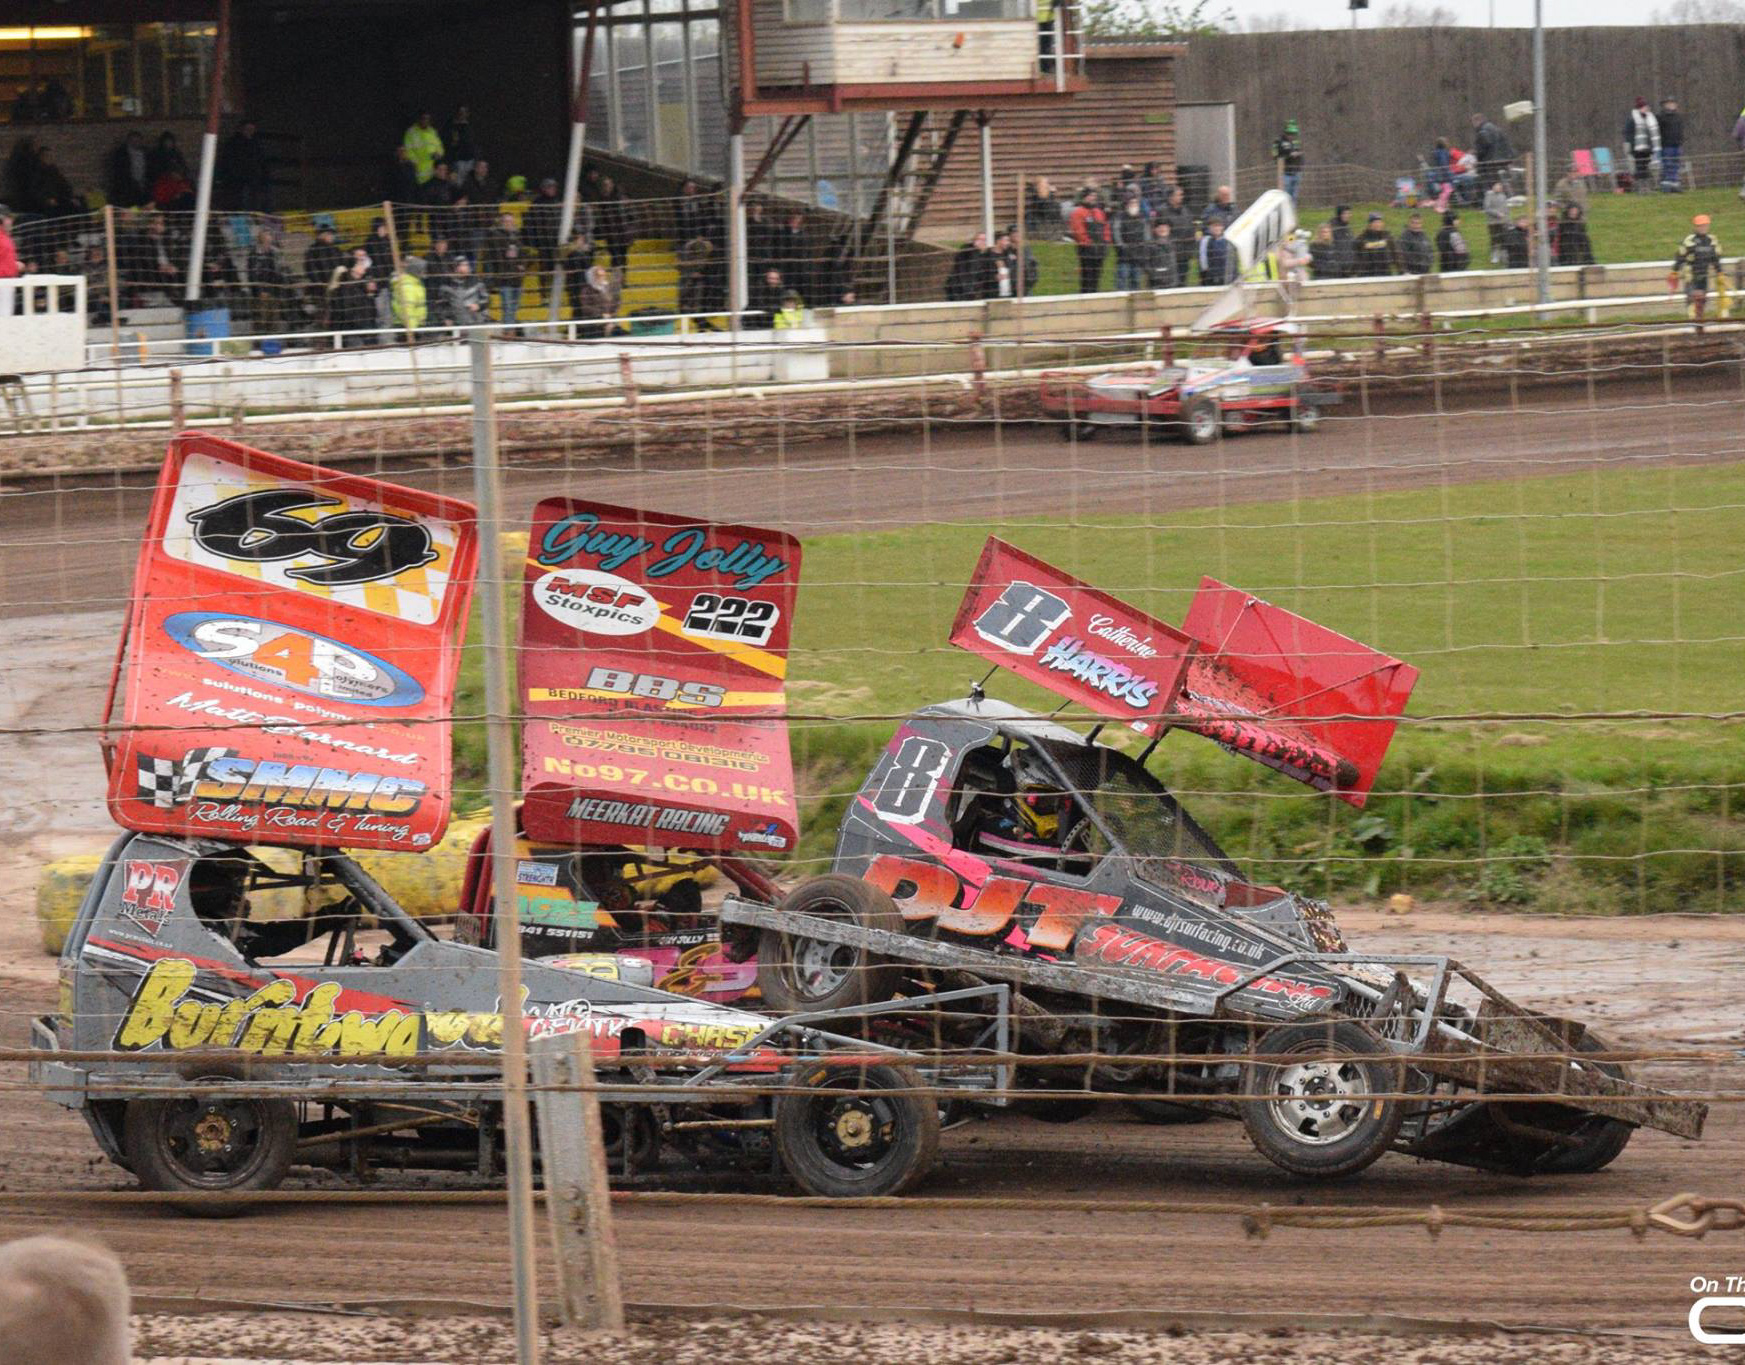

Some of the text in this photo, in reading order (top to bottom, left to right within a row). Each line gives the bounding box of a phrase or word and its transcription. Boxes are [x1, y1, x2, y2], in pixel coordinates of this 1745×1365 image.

[187, 489, 438, 585] 69
[537, 513, 789, 590] Guy Jolly
[545, 594, 644, 625] Stoxpics
[546, 577, 646, 608] MSF
[682, 594, 779, 644] 222
[972, 580, 1073, 655] 8
[1087, 613, 1157, 660] Catherine
[584, 667, 727, 707] BBS
[1036, 634, 1158, 708] HARRIS
[167, 692, 264, 724] Matt
[551, 724, 601, 738] Premier
[606, 731, 677, 748] Motorsport
[872, 736, 953, 826] 8
[187, 802, 260, 831] Rolling
[265, 807, 321, 828] Road
[354, 814, 410, 841] Tuning
[566, 797, 659, 827] MEERKAT
[655, 808, 730, 835] RACING
[122, 861, 178, 912] PR
